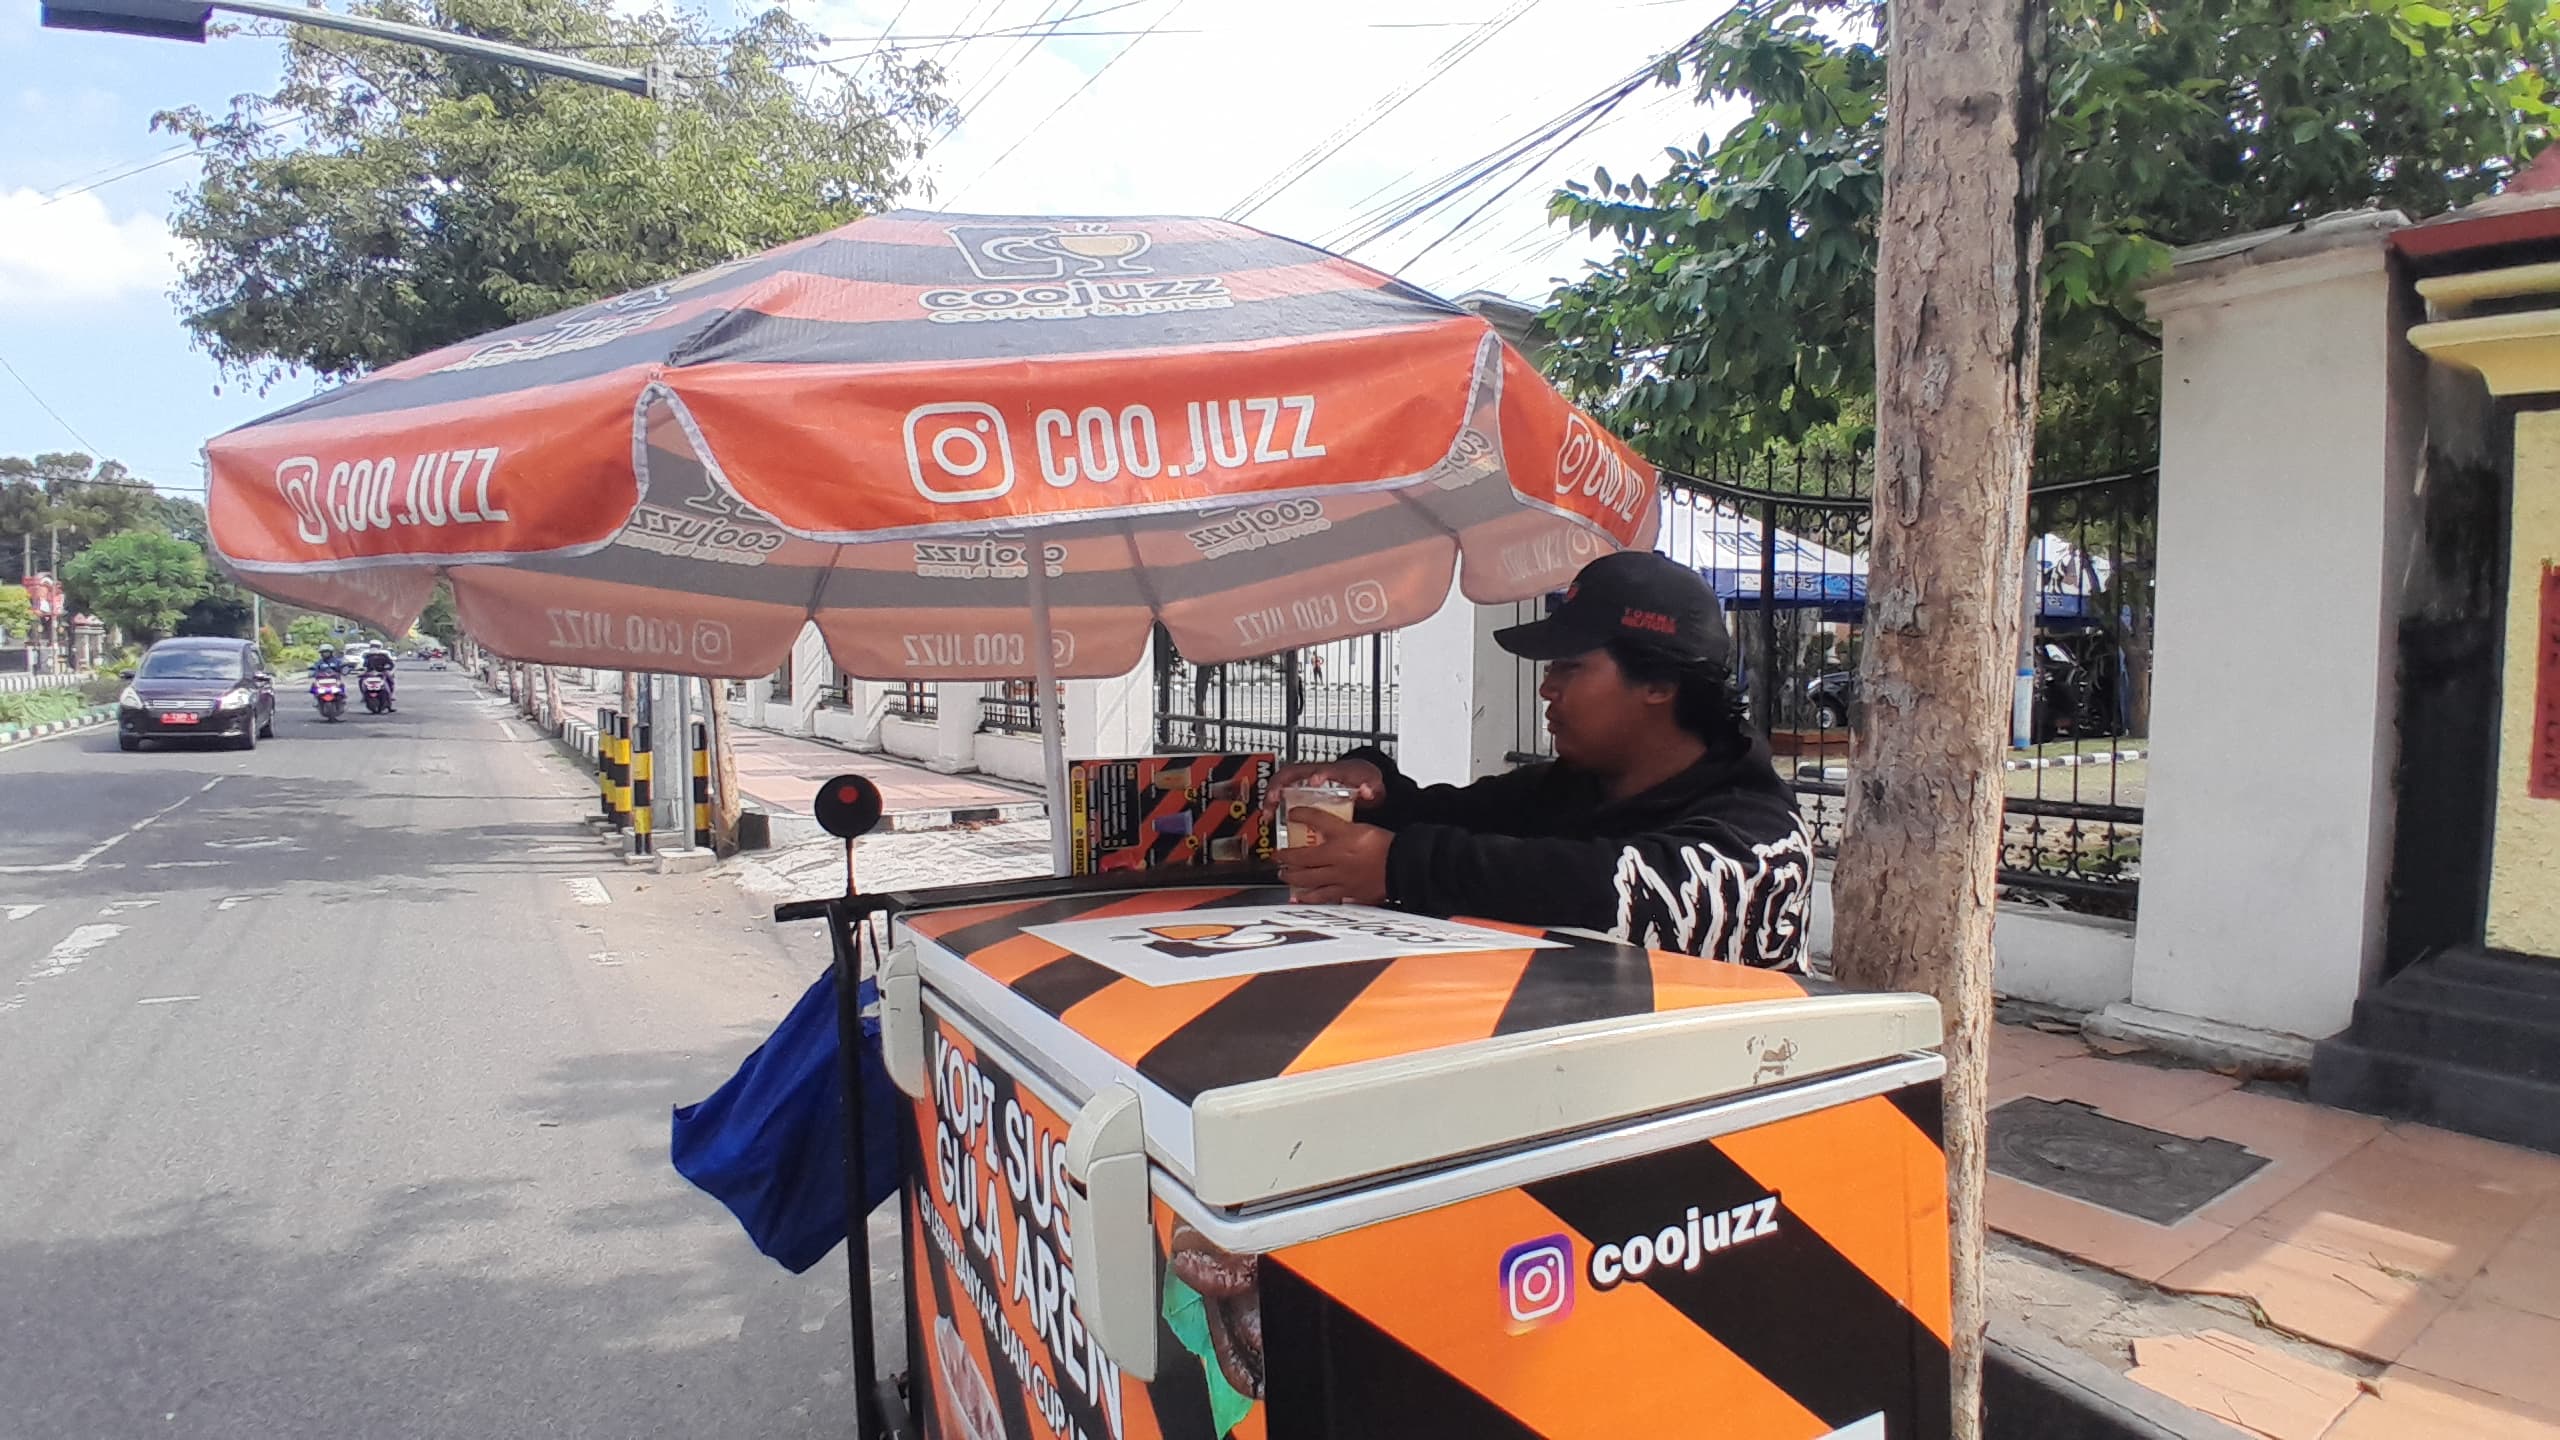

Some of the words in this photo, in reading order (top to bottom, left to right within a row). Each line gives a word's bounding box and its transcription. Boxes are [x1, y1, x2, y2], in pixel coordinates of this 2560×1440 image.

[921, 280, 1224, 309] coojuzz
[324, 445, 510, 533] COO.JUZZ
[1036, 394, 1328, 489] COO.JUZZ
[933, 1029, 1000, 1175] KOPI
[1004, 1098, 1074, 1263] SUS
[936, 1120, 1006, 1286] GULA
[1013, 1213, 1123, 1440] AREN
[1591, 1195, 1779, 1286] coojuzz
[953, 1239, 1000, 1342] BANYAK
[1000, 1310, 1031, 1391] DAN
[1032, 1364, 1066, 1439] CUP
